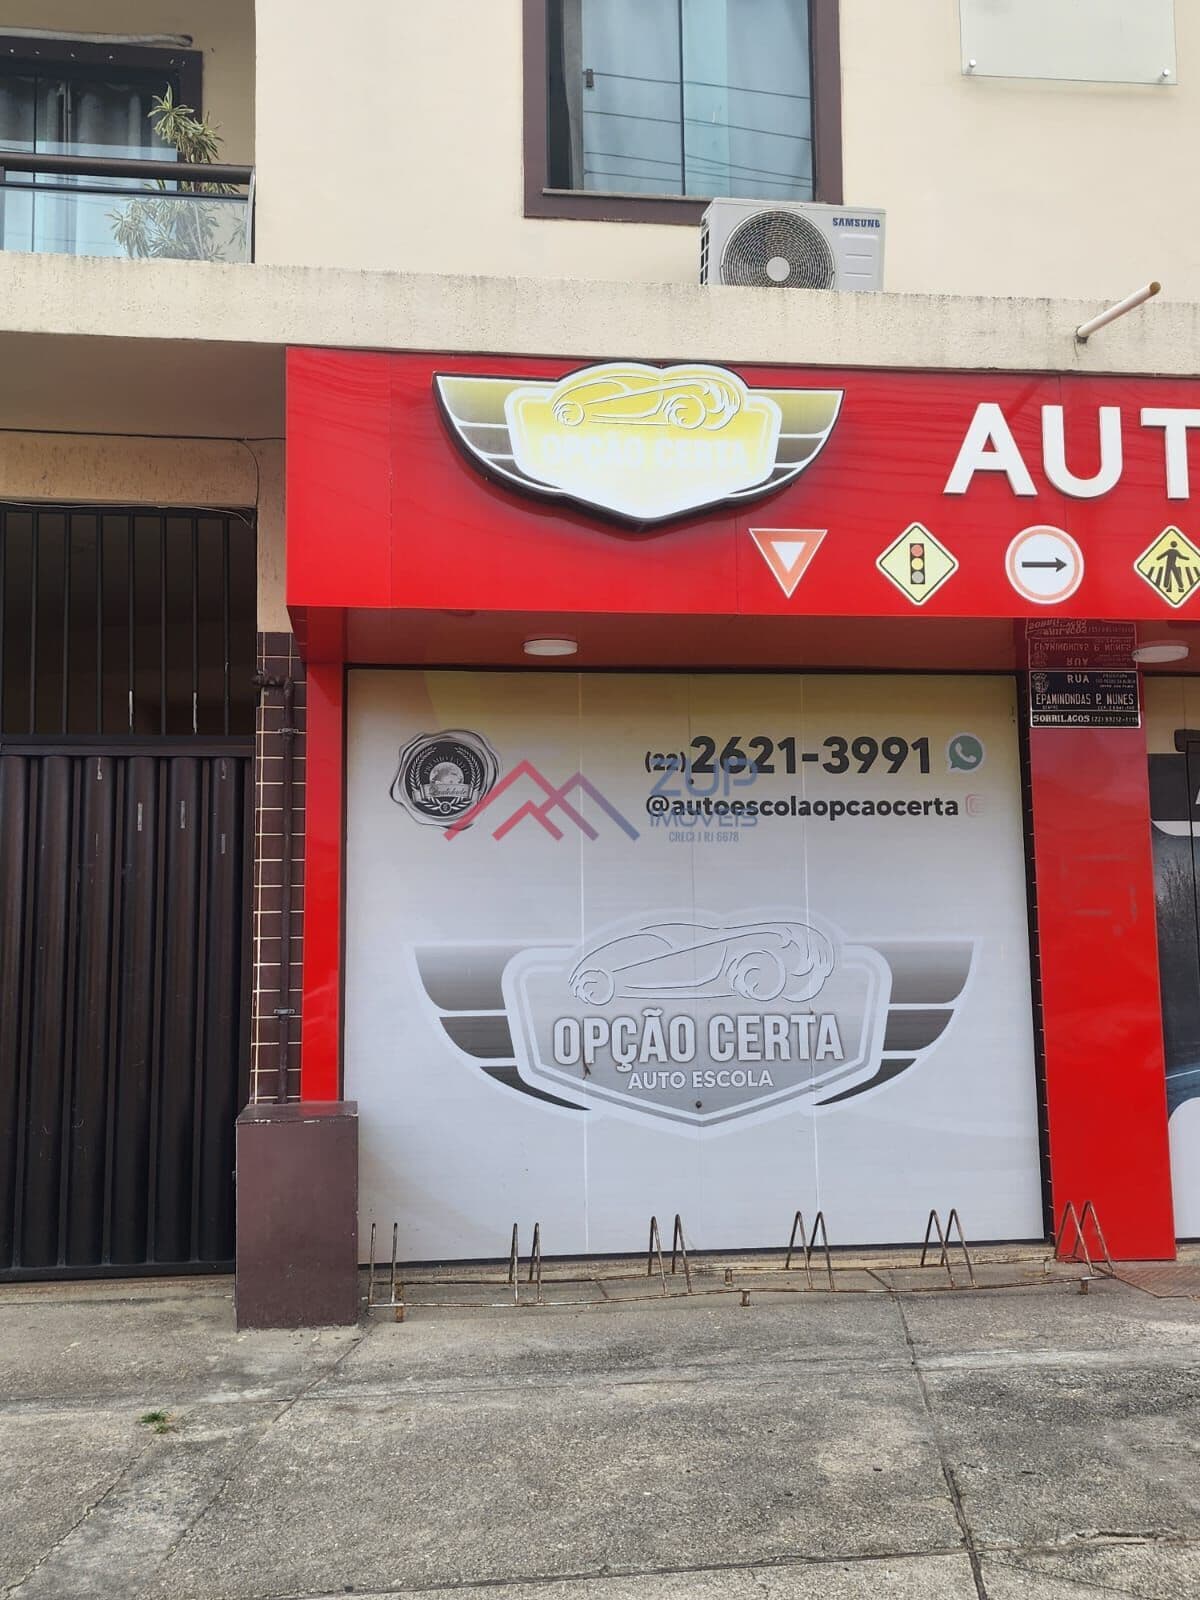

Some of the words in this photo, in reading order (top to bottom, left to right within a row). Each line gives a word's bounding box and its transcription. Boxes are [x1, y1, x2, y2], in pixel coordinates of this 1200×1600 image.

[832, 217, 880, 228] SAMSUNG
[542, 431, 644, 470] OPÇÃO
[654, 437, 749, 468] CERTA
[943, 402, 1200, 500] AUT
[1067, 674, 1090, 684] RUA
[1035, 693, 1091, 705] EPAMINONDAS
[1106, 693, 1134, 705] NUNES
[644, 751, 687, 773] (22)
[690, 736, 930, 774] 2621-3991
[646, 795, 959, 821] @autoescolaopcaocerta
[553, 1007, 697, 1073] OPÇÃO
[708, 1013, 845, 1062] CERTA
[628, 1071, 686, 1090] AUTO
[692, 1070, 774, 1088] ESCOLA
